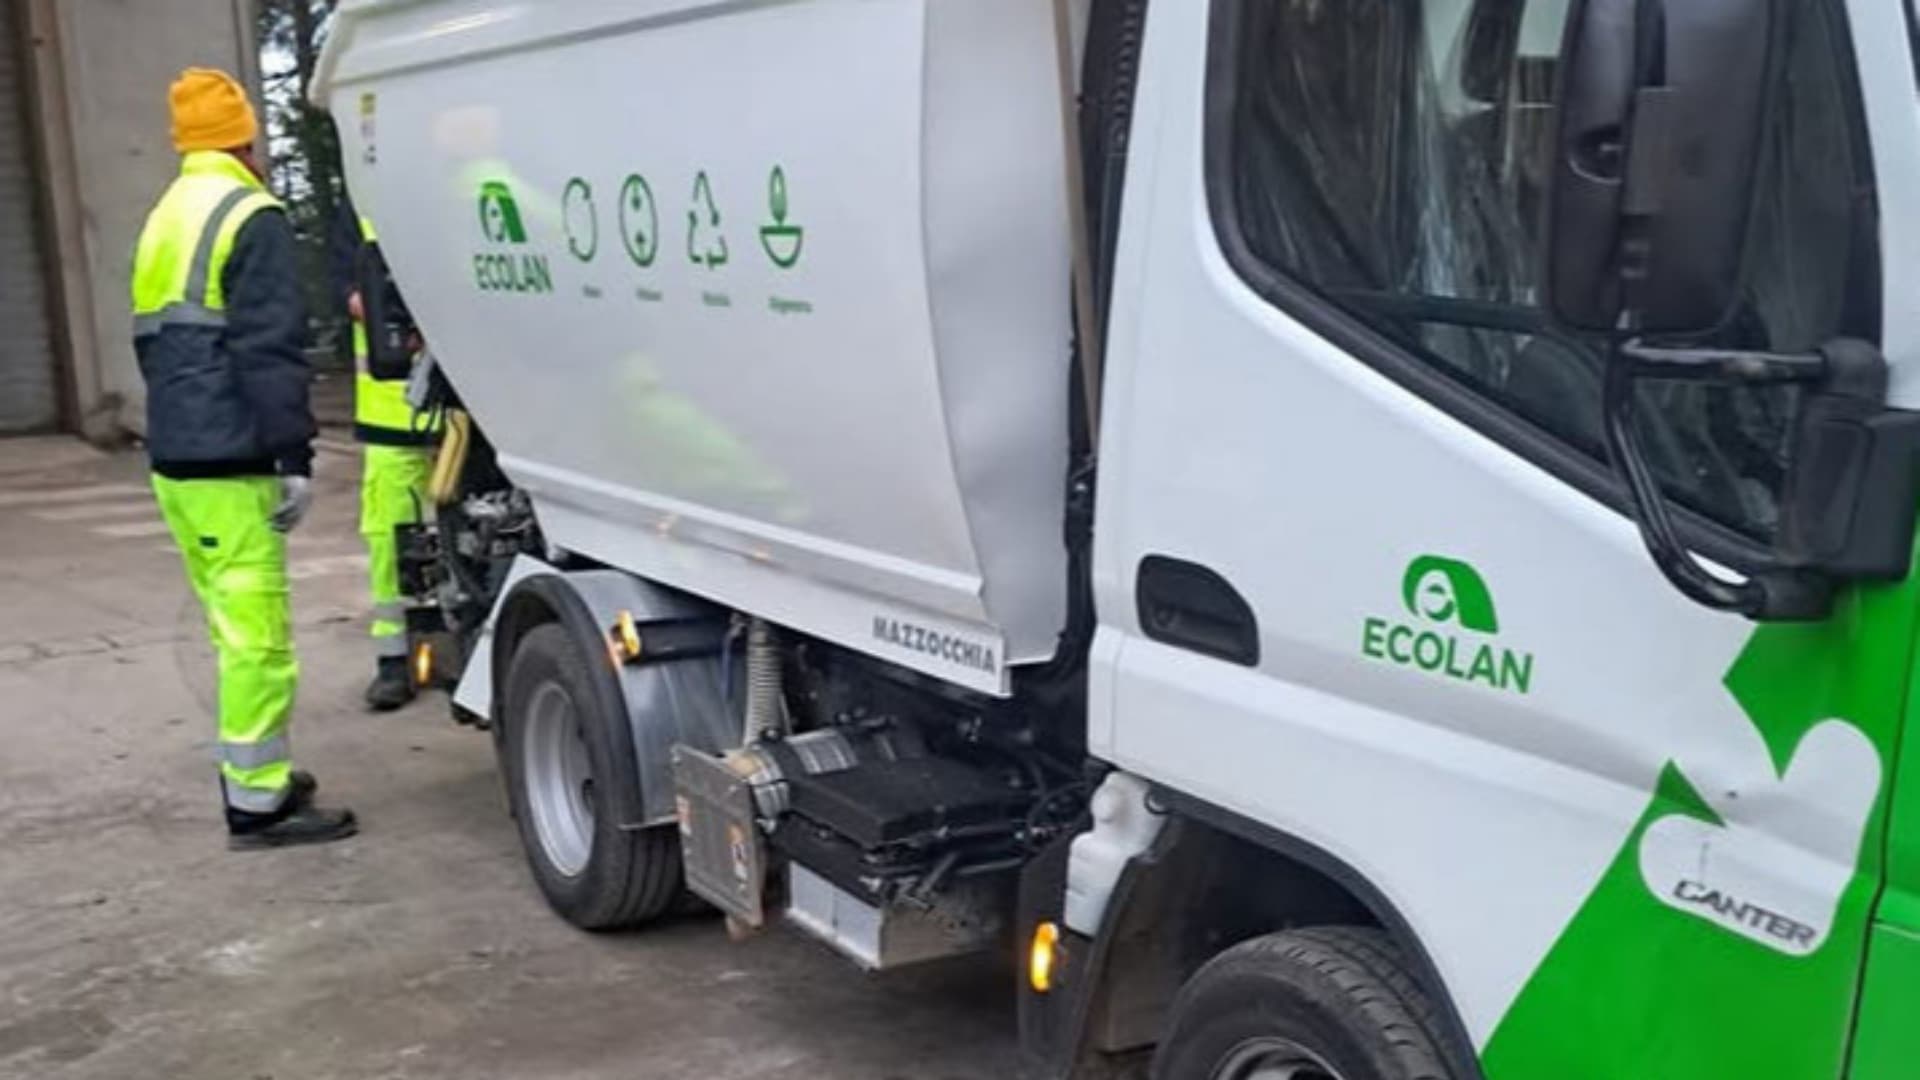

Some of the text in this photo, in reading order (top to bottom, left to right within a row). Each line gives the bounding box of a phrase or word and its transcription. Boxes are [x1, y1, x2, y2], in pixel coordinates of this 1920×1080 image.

[474, 254, 553, 293] ECOLAN
[872, 616, 996, 674] MAZZOCCHIA
[1362, 617, 1533, 694] ECOLAN
[1673, 879, 1817, 949] CANTER
